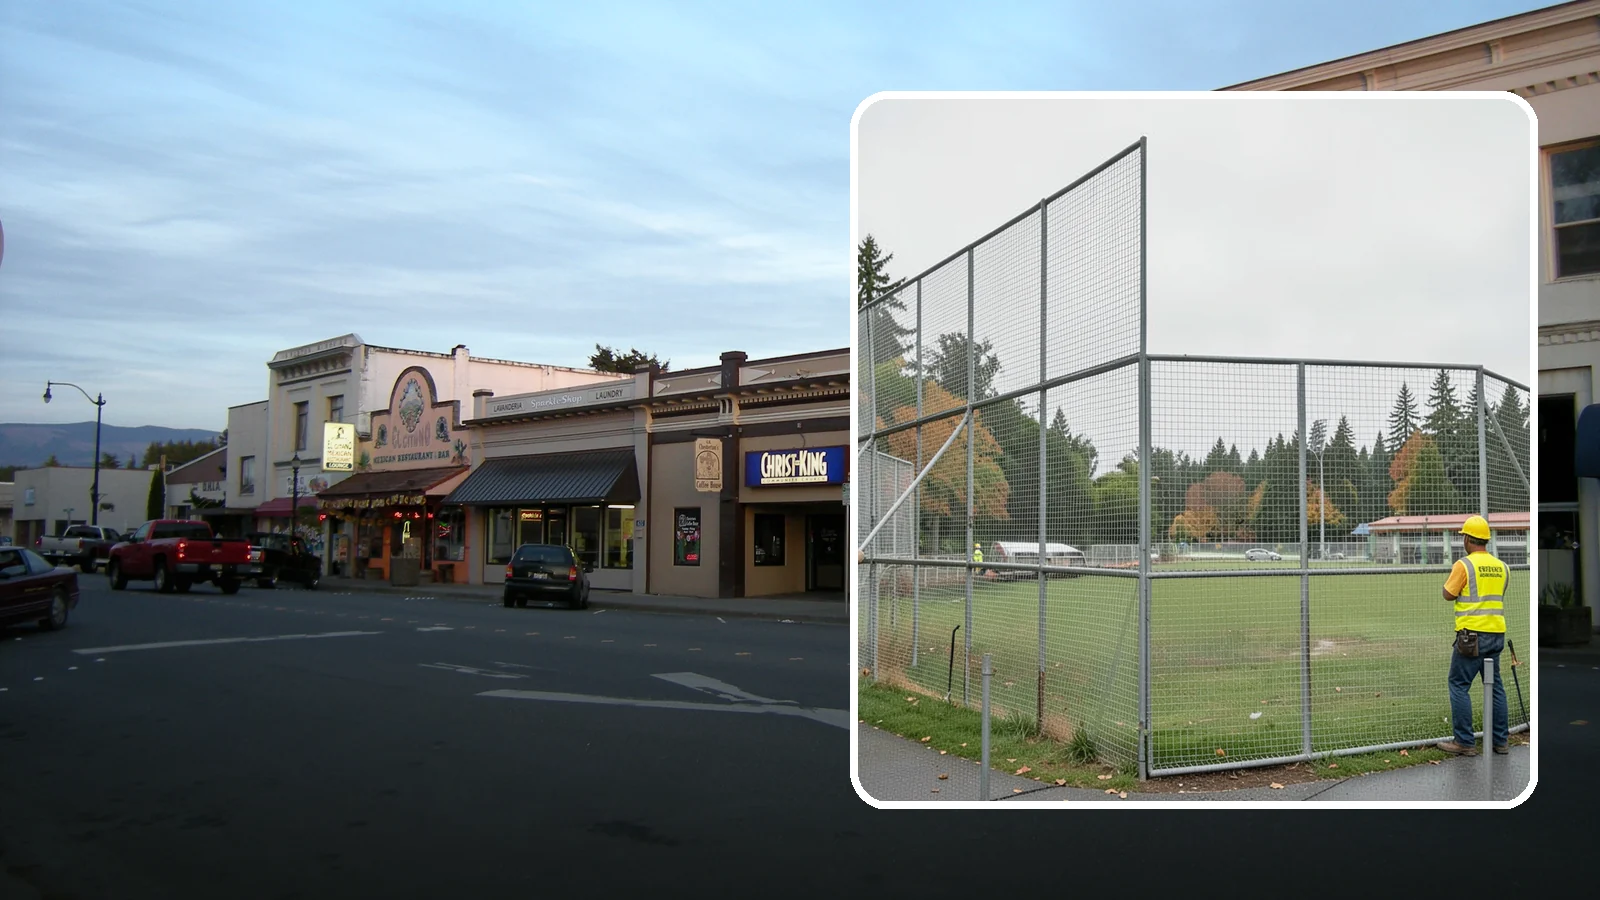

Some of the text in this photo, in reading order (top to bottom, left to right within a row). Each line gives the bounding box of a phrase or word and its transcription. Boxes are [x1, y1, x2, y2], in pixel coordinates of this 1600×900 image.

[595, 389, 623, 399] LAUNDRY
[493, 402, 522, 412] LAVANDERIA
[397, 451, 433, 462] RESTAURANT
[437, 450, 450, 459] BAR
[761, 450, 827, 478] CHRIST KING
